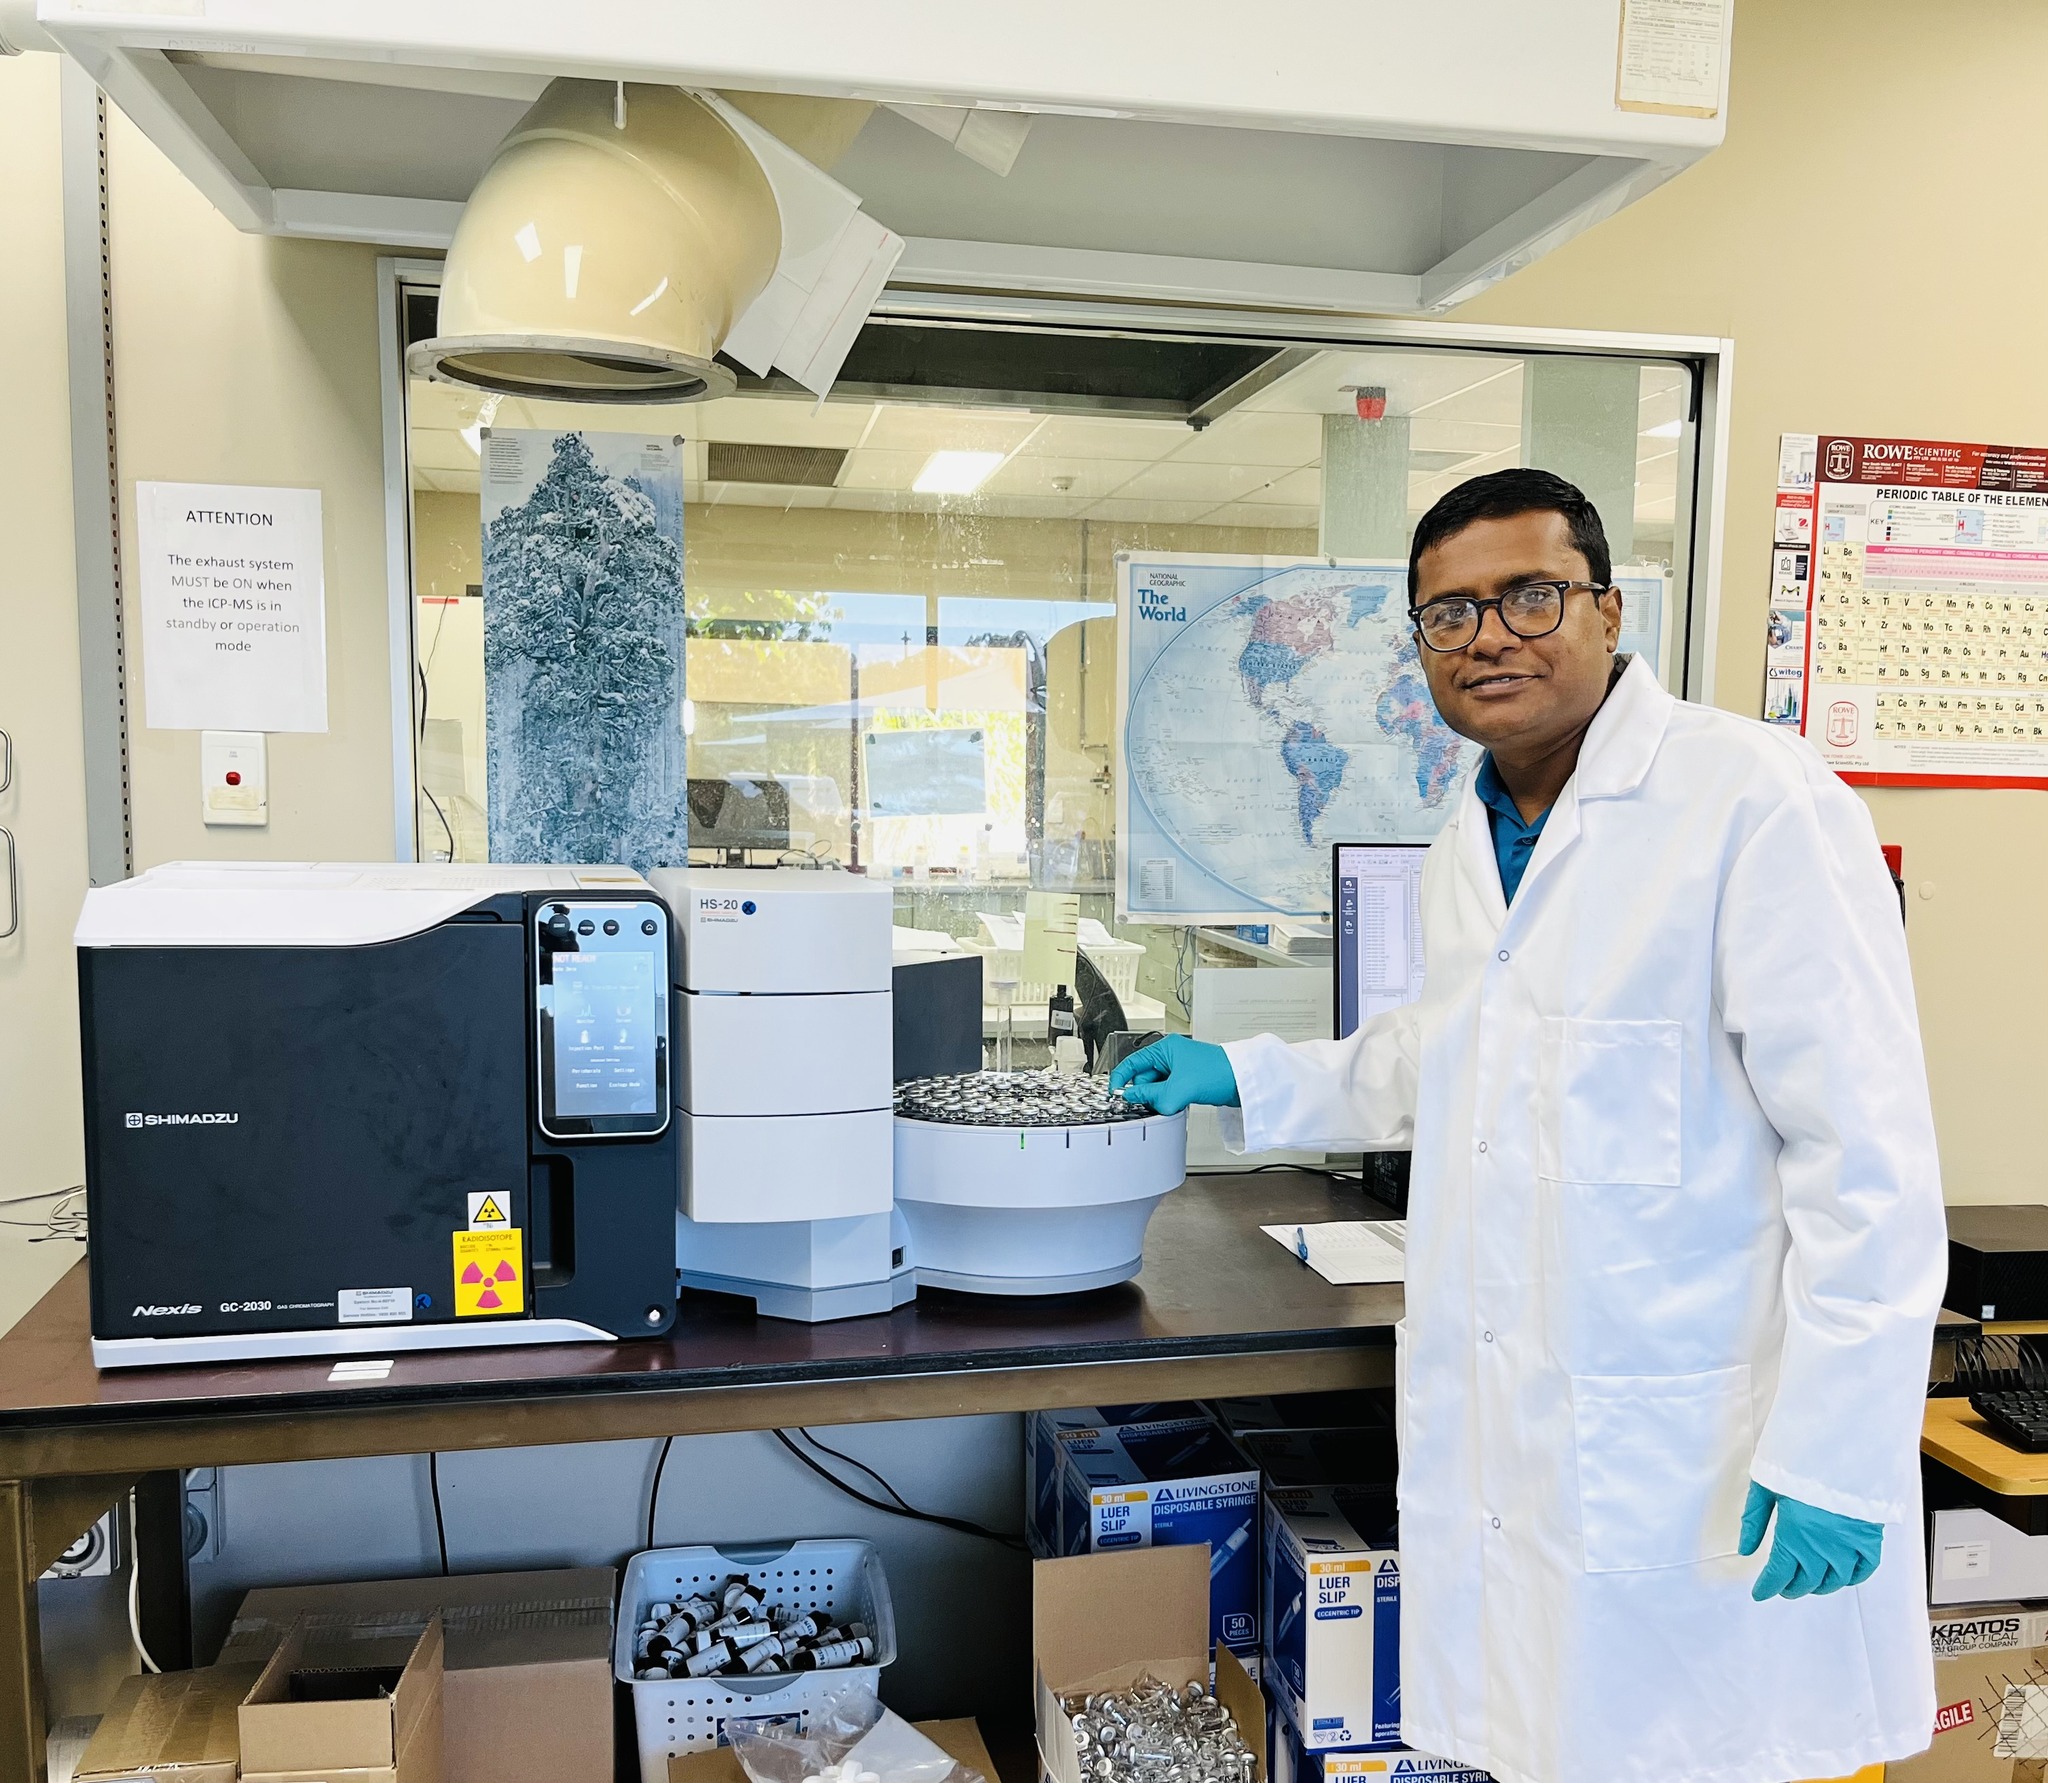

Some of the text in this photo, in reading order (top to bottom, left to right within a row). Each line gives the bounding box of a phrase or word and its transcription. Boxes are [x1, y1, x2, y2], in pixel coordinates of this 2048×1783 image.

[1830, 444, 1851, 452] ROWE
[1862, 443, 1961, 460] ROWE SCIENTIFIC
[1876, 489, 1929, 501] PERIODIC
[1931, 490, 1965, 502] TABLE
[1967, 493, 1981, 503] OF
[1984, 494, 2004, 504] THE
[186, 510, 274, 527] ATTENTION
[1824, 522, 1830, 531] H
[1958, 520, 1965, 531] H
[1824, 547, 1853, 556] Li Be
[168, 554, 294, 572] The exhaust system
[1822, 571, 1852, 581] Na Mg
[171, 576, 293, 591] MUST be ON when
[1149, 579, 1186, 587] GEOGRAPHIC
[1138, 589, 1169, 605] The
[1820, 595, 1825, 603] K
[1840, 595, 1849, 604] Ca
[1862, 597, 1870, 605] Sc
[1883, 598, 1890, 606] Ti
[1925, 599, 1933, 607] Cr
[1946, 600, 1957, 608] Mn
[1967, 601, 1975, 609] Fe
[1985, 602, 1993, 610] Co
[2003, 603, 2011, 611] Ni
[183, 597, 282, 612] the ICP-MS is in
[1138, 605, 1187, 622] World
[166, 618, 300, 634] standby or operation
[1819, 619, 2032, 637] Rb Sr Y Zr Nb Mo Tc Pd Ag
[215, 640, 251, 652] mode
[1817, 642, 2029, 658] Cs Ba Ta W Pt Au
[1817, 666, 1846, 674] Fr Ra
[1832, 706, 1855, 714] ROWE
[1877, 699, 1885, 707] La
[1898, 699, 1907, 708] Ce
[1919, 699, 1926, 708] Pr
[1939, 701, 1948, 709] Nd
[1976, 702, 1986, 710] Sm
[1995, 703, 2003, 711] Eu
[2015, 703, 2024, 712] Gd
[2036, 704, 2044, 712] Tb
[1875, 722, 1884, 730] Ac
[1917, 723, 1926, 731] Pa
[1938, 724, 1943, 732] U
[1993, 726, 2004, 734] Am
[2013, 727, 2024, 735] Cm
[2033, 727, 2042, 735] Bk
[700, 899, 738, 910] HS-20
[553, 954, 570, 963] NOT
[144, 1112, 239, 1125] SHIMADZU
[462, 1234, 512, 1242] RADIOISOTOPE
[132, 1303, 203, 1318] Nexis
[220, 1301, 272, 1313] GC-2030
[289, 1302, 335, 1310] CHROMATOGRAPH
[1136, 1417, 1208, 1431] LIVINGSTONE
[1120, 1429, 1173, 1439] DISPOSABLE
[1176, 1480, 1257, 1498] LIVINGSTONE
[1101, 1494, 1125, 1504] 30 ml
[1154, 1494, 1257, 1516] DISPOSABLE SYRINGE
[1101, 1506, 1130, 1519] LUER
[1101, 1519, 1126, 1532] SLIP
[1100, 1536, 1130, 1544] ECCENTRIC
[1320, 1563, 1345, 1573] 30 ml
[1319, 1577, 1350, 1589] LUER
[1377, 1577, 1400, 1588] DISP
[1319, 1591, 1346, 1604] SLIP
[1318, 1609, 1349, 1617] ECCENTRIC
[1231, 1617, 1245, 1628] 50
[1931, 1618, 2020, 1639] KRATOS
[1230, 1628, 1249, 1636] PIECES
[1931, 1632, 2018, 1646] ANALYTICAL
[1948, 1644, 1976, 1653] GROUP
[1979, 1641, 2018, 1649] COMPANY
[1375, 1723, 1400, 1731] Featuring
[1350, 1763, 1361, 1771] ml
[1418, 1761, 1470, 1771] LIVING
[1393, 1773, 1459, 1783] DISPOSABLE
